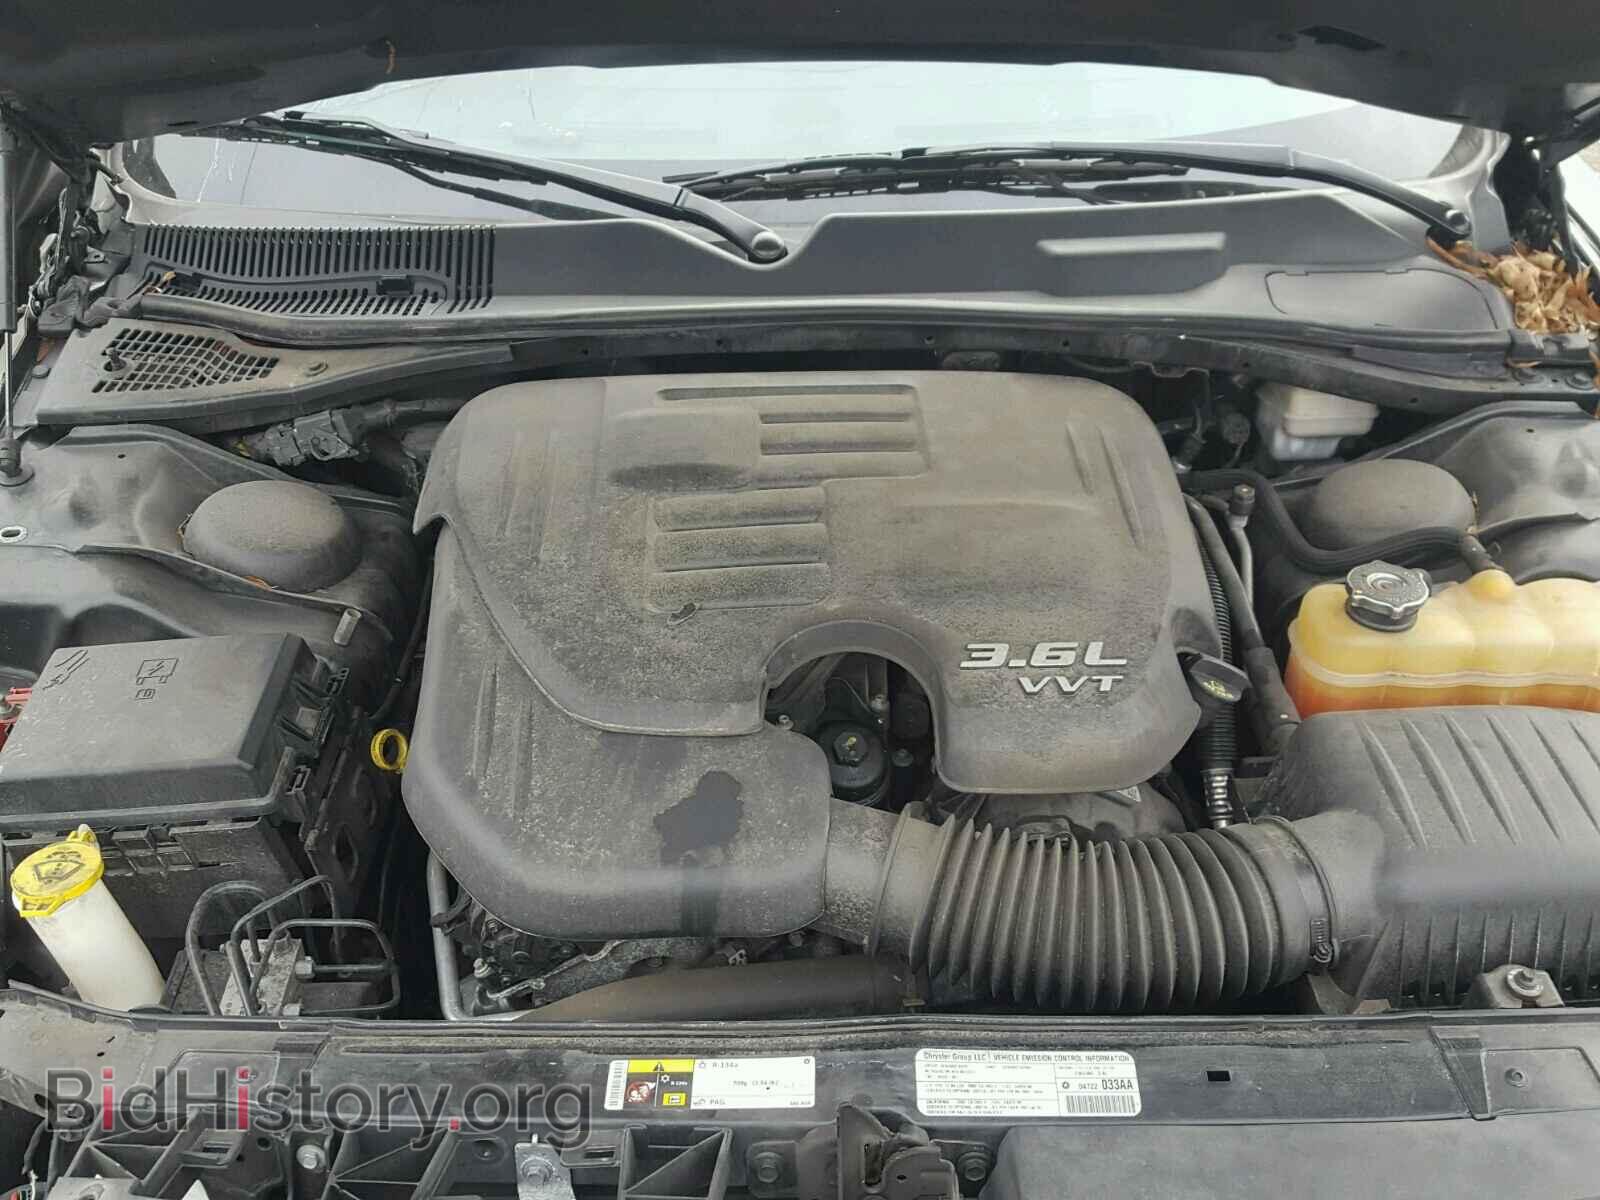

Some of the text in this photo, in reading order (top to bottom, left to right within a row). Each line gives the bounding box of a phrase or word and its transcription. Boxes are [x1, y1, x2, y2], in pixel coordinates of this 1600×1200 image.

[960, 642, 1127, 668] 3.6L
[1018, 676, 1124, 693] VVT
[923, 1052, 950, 1062] Chrysler
[952, 1053, 972, 1062] Group
[973, 1053, 986, 1061] LLC
[1021, 1054, 1052, 1062] EMISSION
